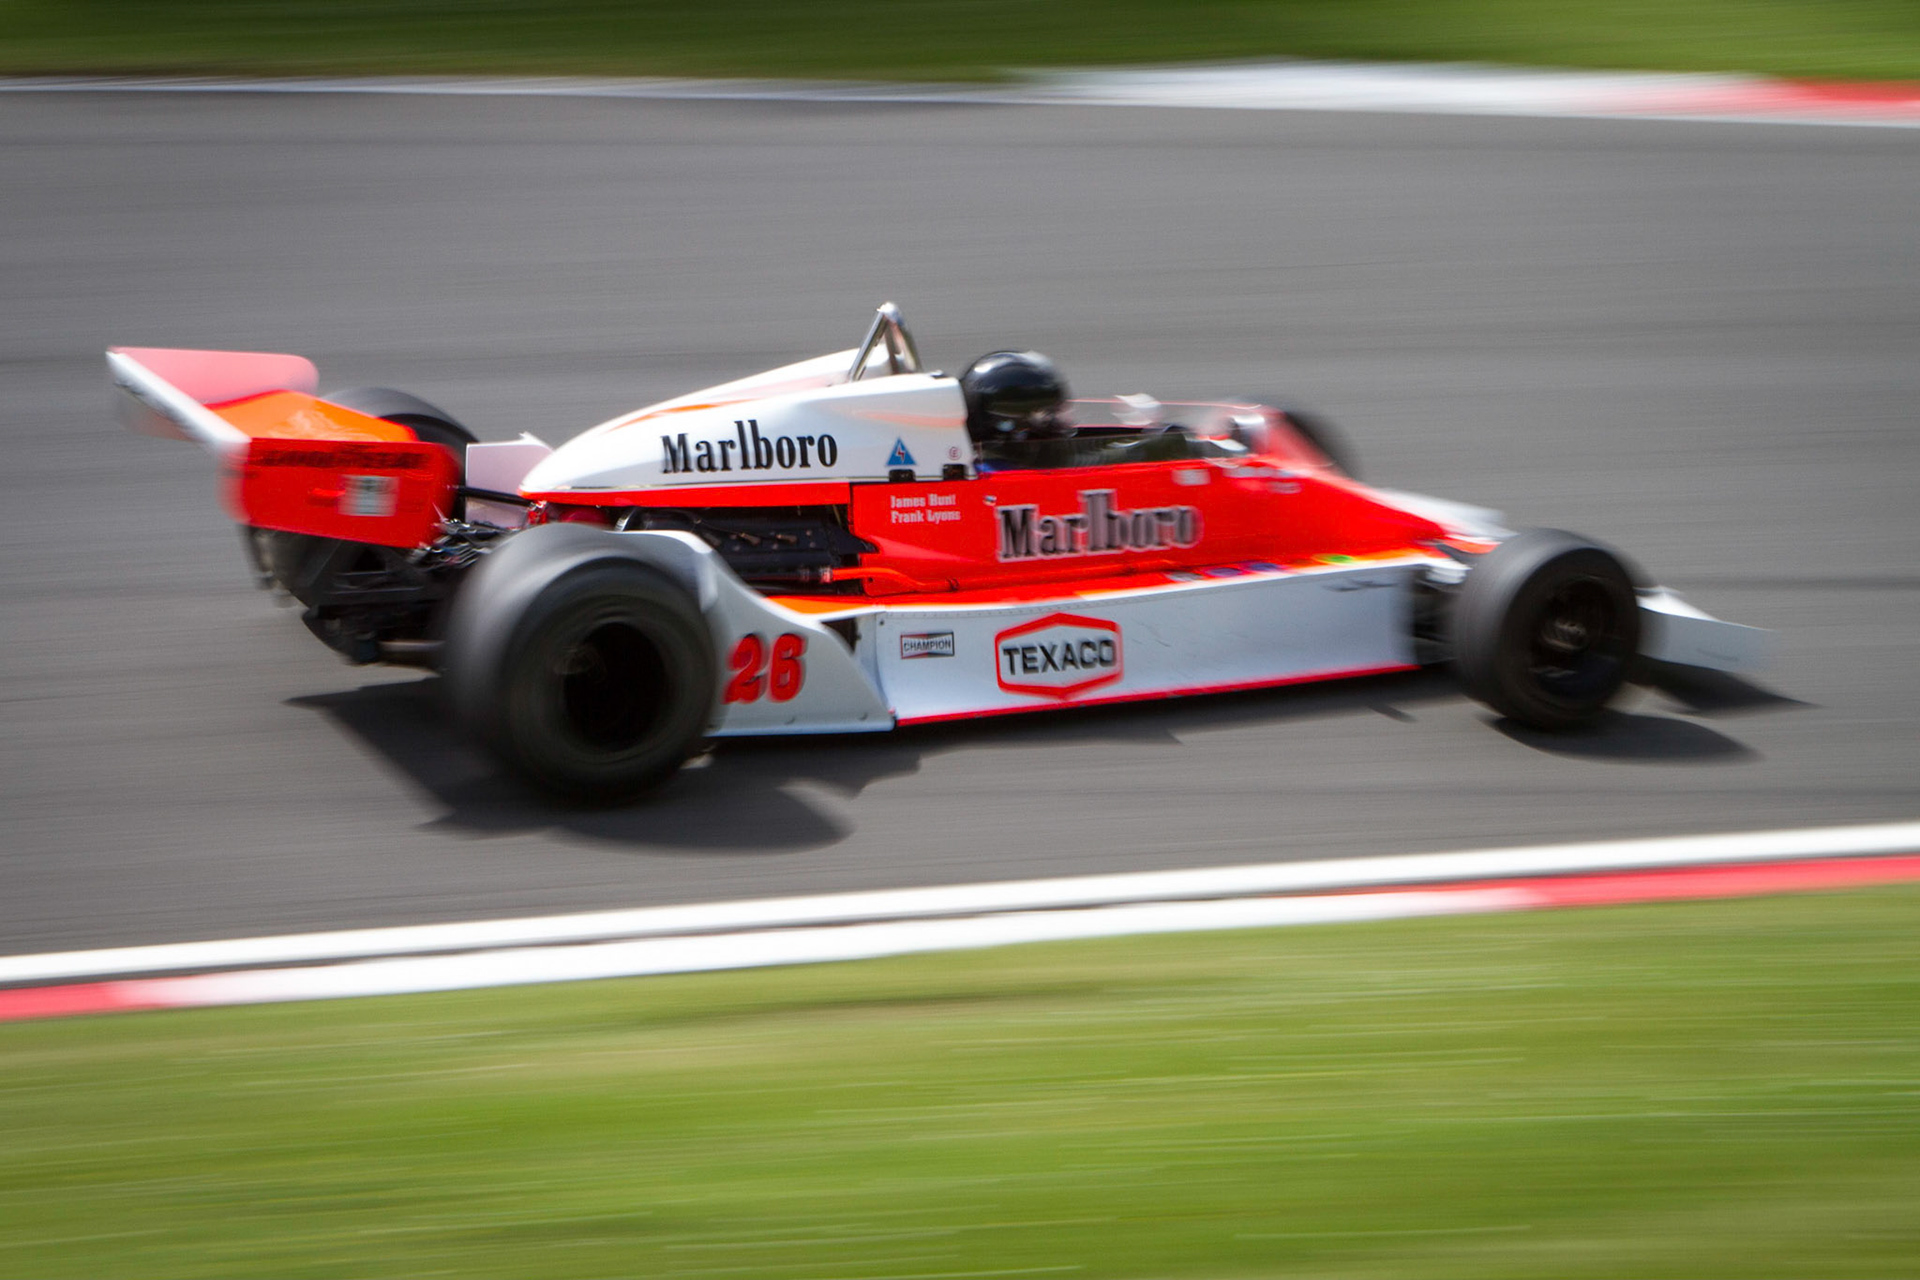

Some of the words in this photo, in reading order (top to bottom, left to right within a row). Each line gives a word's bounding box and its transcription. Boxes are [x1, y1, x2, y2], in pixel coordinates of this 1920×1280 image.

[660, 419, 838, 474] Marlboro
[890, 495, 926, 509] James
[928, 493, 956, 506] Hunt
[891, 509, 925, 524] Frank
[927, 509, 961, 525] Lyons
[998, 490, 1203, 562] Marlboro
[903, 639, 952, 652] CHAMPION
[1002, 637, 1118, 675] TEXACO
[721, 633, 808, 706] 26
